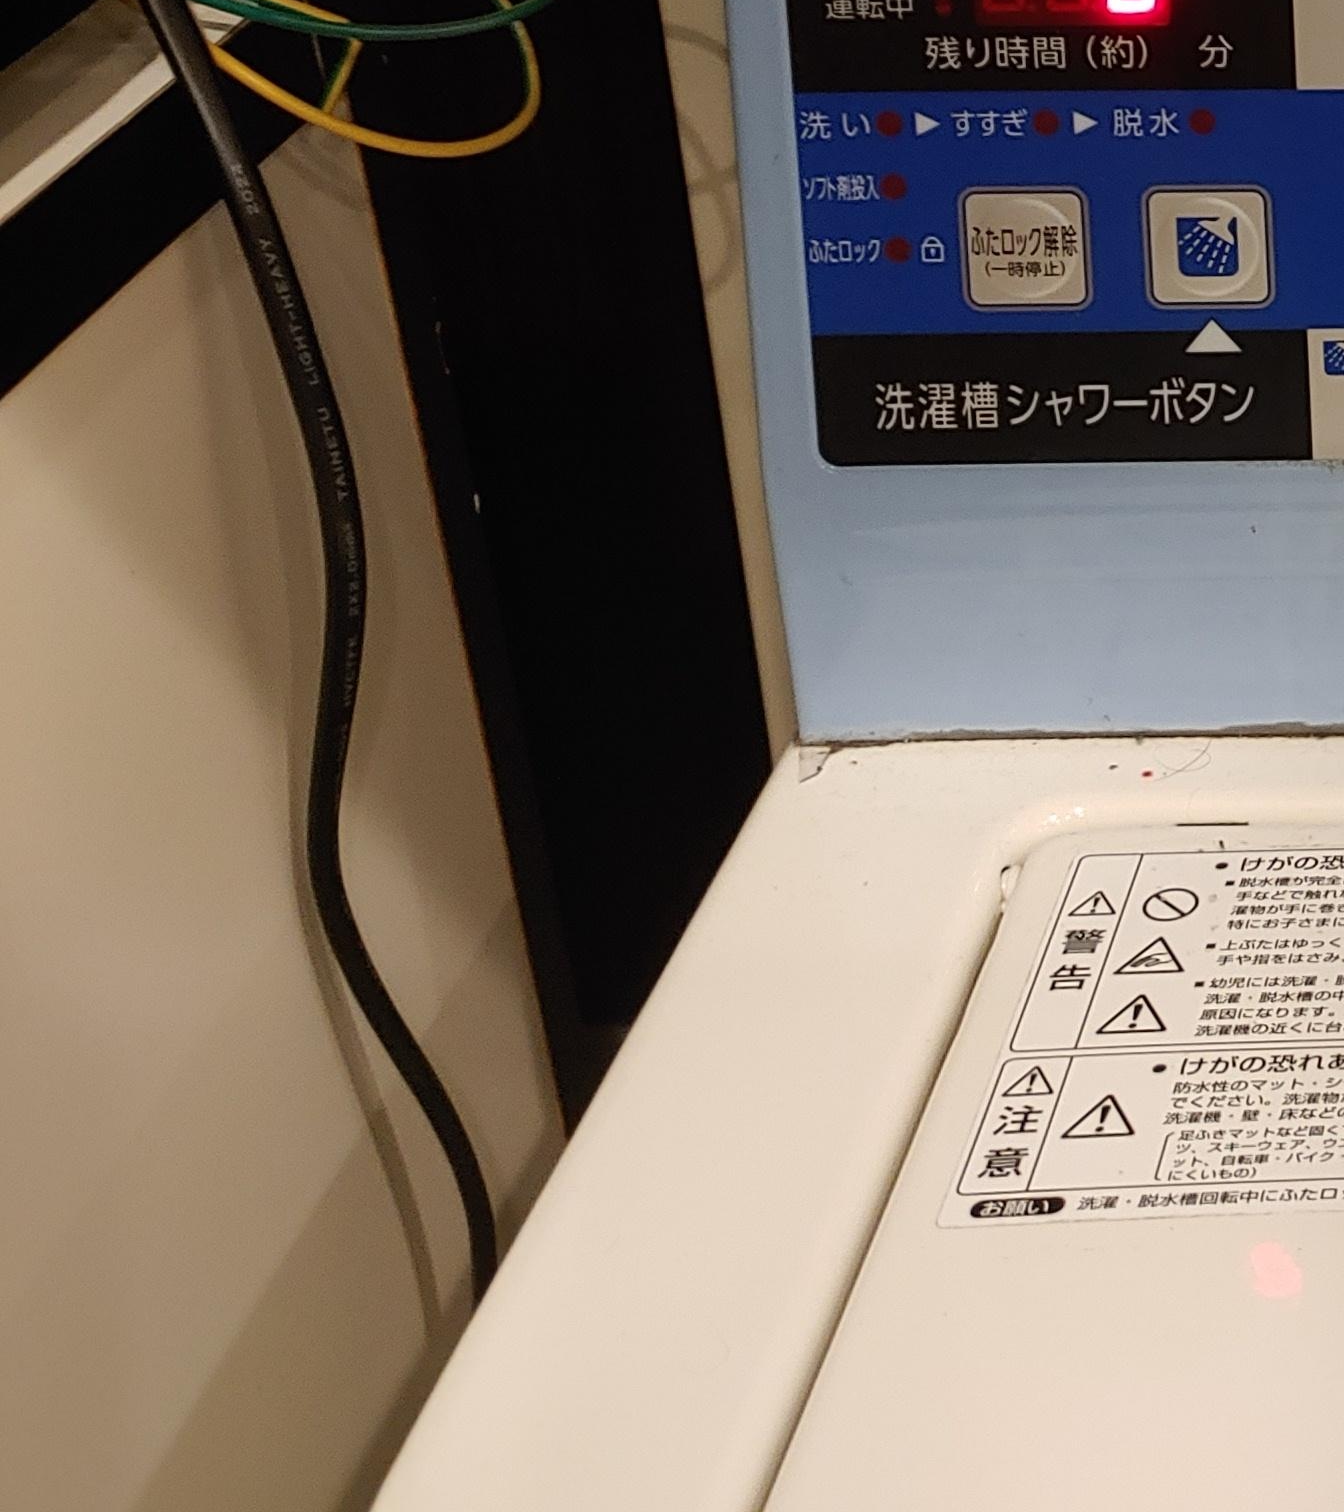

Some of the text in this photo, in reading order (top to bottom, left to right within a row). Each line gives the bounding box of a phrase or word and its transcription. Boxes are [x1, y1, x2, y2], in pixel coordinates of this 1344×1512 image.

[1198, 35, 1233, 69] 分
[799, 108, 1180, 140] 洗い すすぎ 脱水
[802, 175, 880, 201] ソフト剤投入
[808, 237, 881, 264] ふたロック
[971, 225, 1079, 258] ふたロック解除
[984, 260, 1066, 279] （一時停止）
[257, 235, 319, 387] LIGHT-HEAVY
[874, 376, 1256, 432] 洗濯槽シャワーボタン
[1049, 929, 1107, 991] 警告
[978, 1105, 1043, 1178] 注意
[979, 1199, 1051, 1217] お願い
